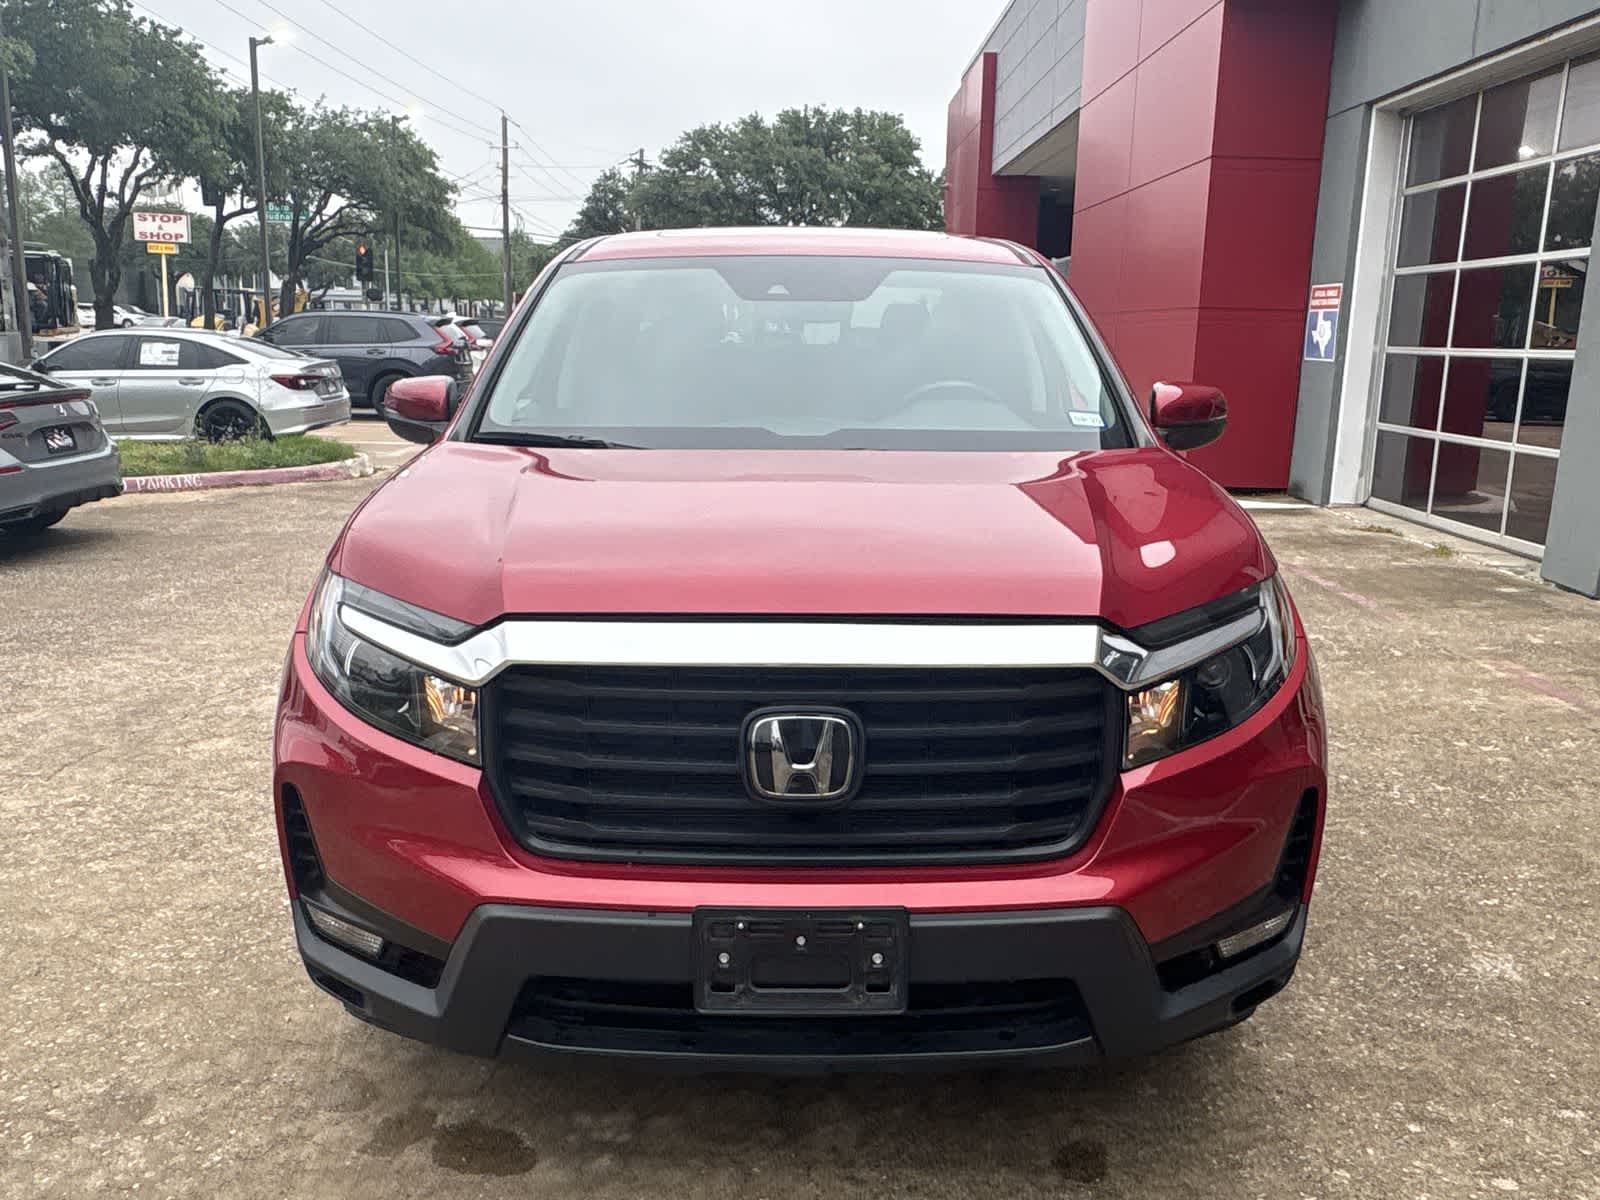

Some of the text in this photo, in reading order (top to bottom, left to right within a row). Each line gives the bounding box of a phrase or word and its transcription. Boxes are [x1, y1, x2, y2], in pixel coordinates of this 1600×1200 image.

[137, 213, 183, 223] STOP
[138, 231, 184, 241] SHOP
[136, 475, 202, 491] PARKING
